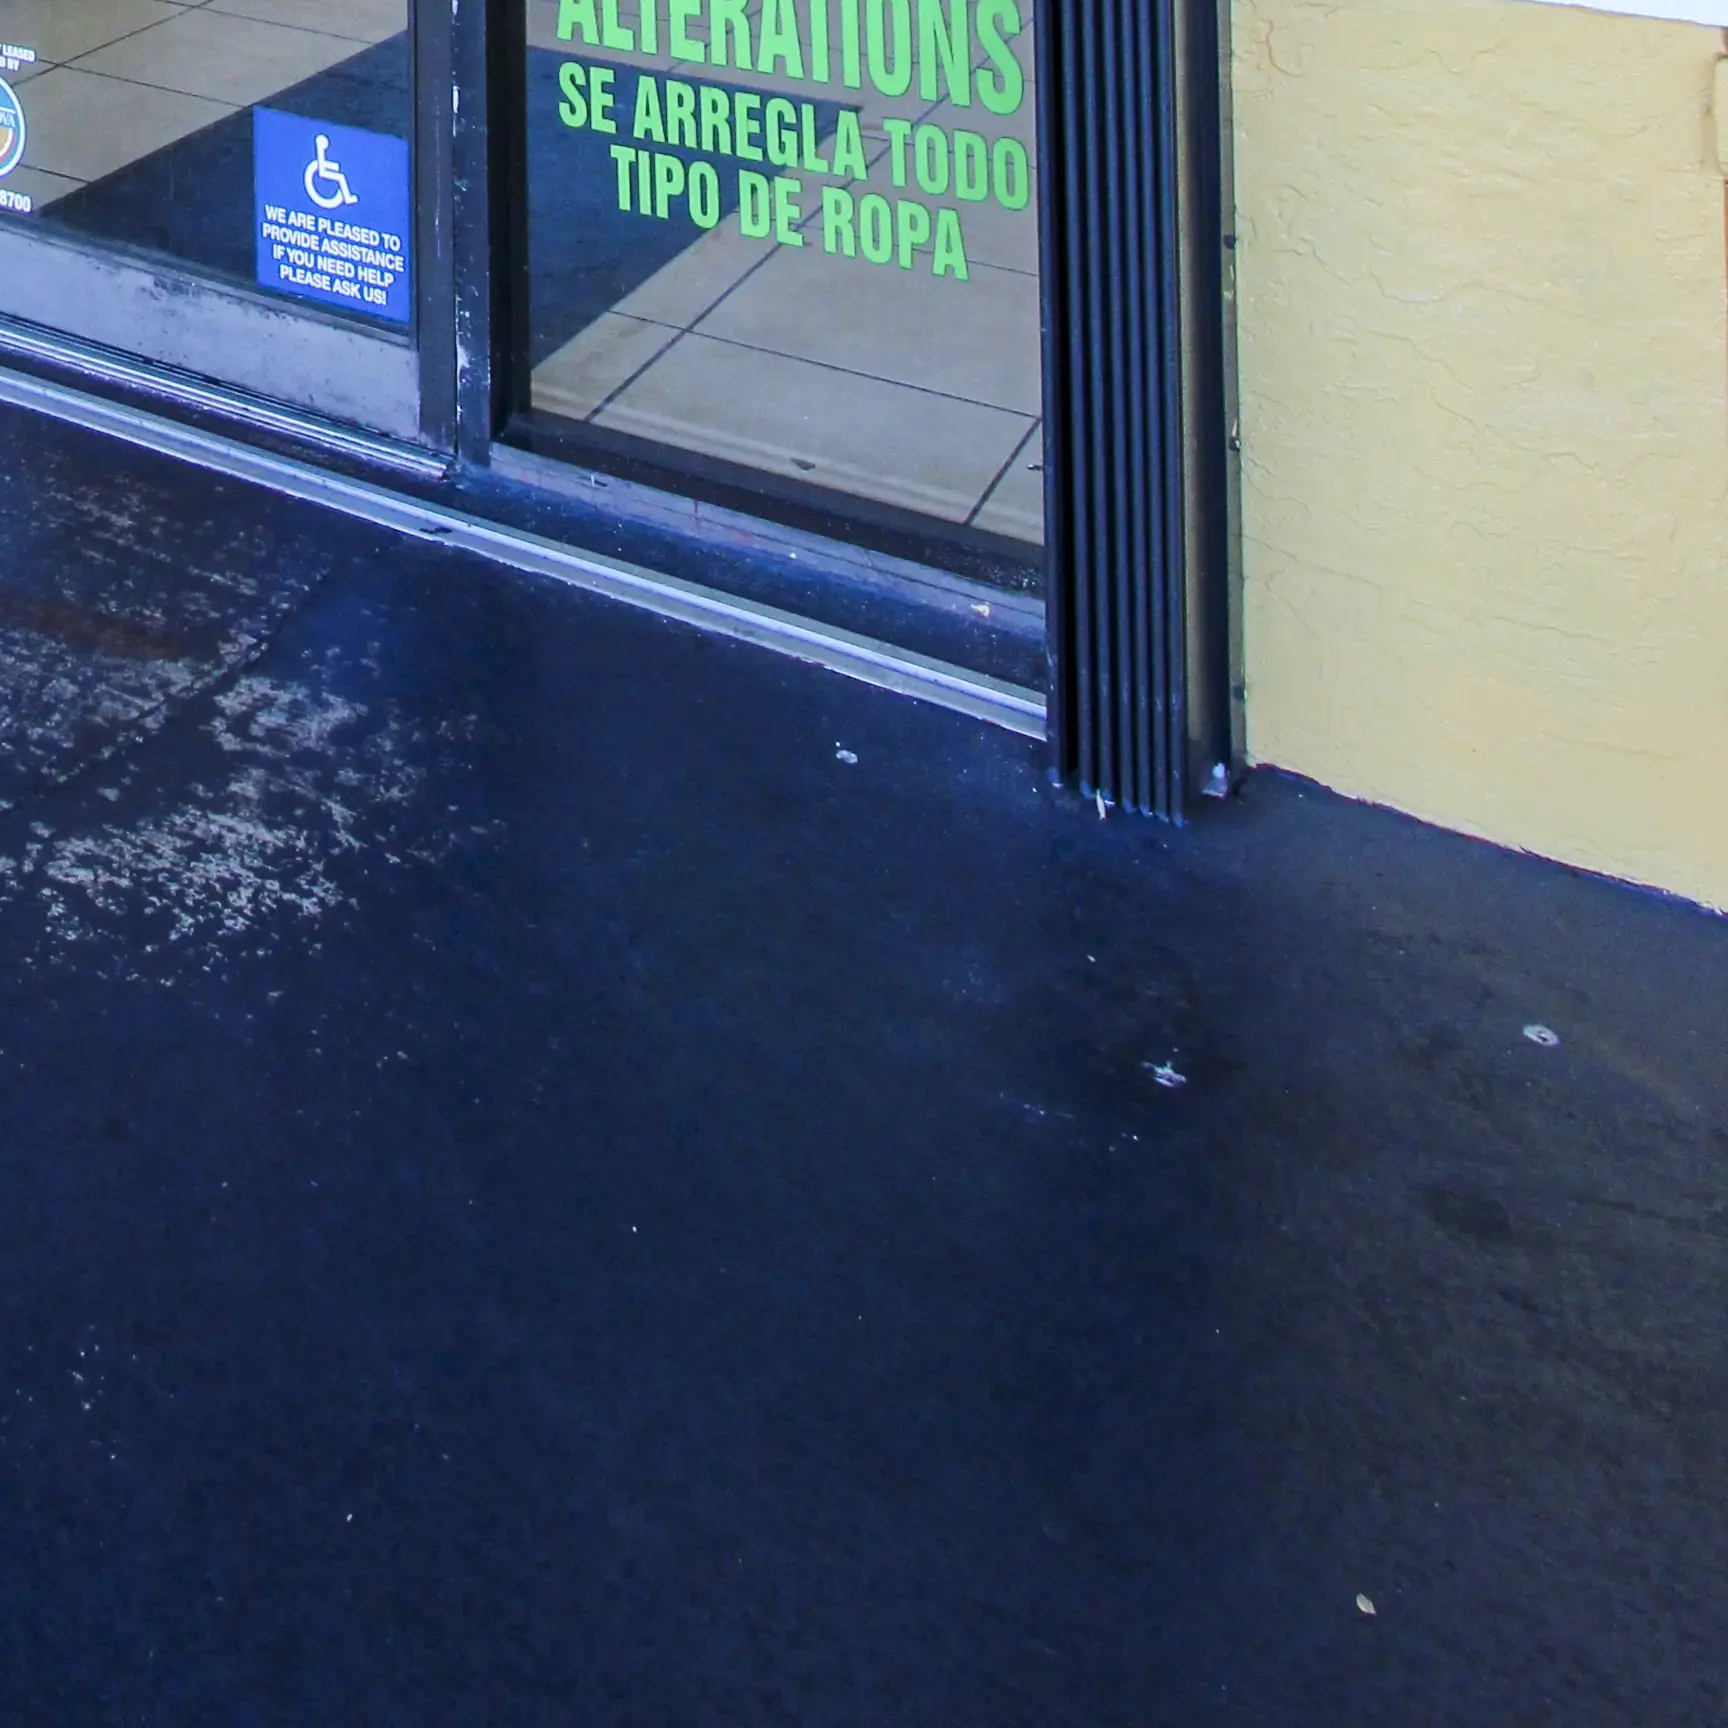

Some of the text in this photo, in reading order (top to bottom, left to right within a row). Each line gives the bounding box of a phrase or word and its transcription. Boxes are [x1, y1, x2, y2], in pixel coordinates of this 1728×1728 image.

[2, 43, 36, 62] LEASED
[557, 62, 1030, 211] SE ARREGLA TODO
[264, 204, 401, 251] WE ARE PLEASED TO
[610, 143, 970, 282] TIPO DE ROPA
[262, 222, 405, 273] PROVIDE ASSISTANCE
[272, 244, 395, 288] IF YOU NEED HELP
[279, 264, 387, 306] PLEASE ASK US!
